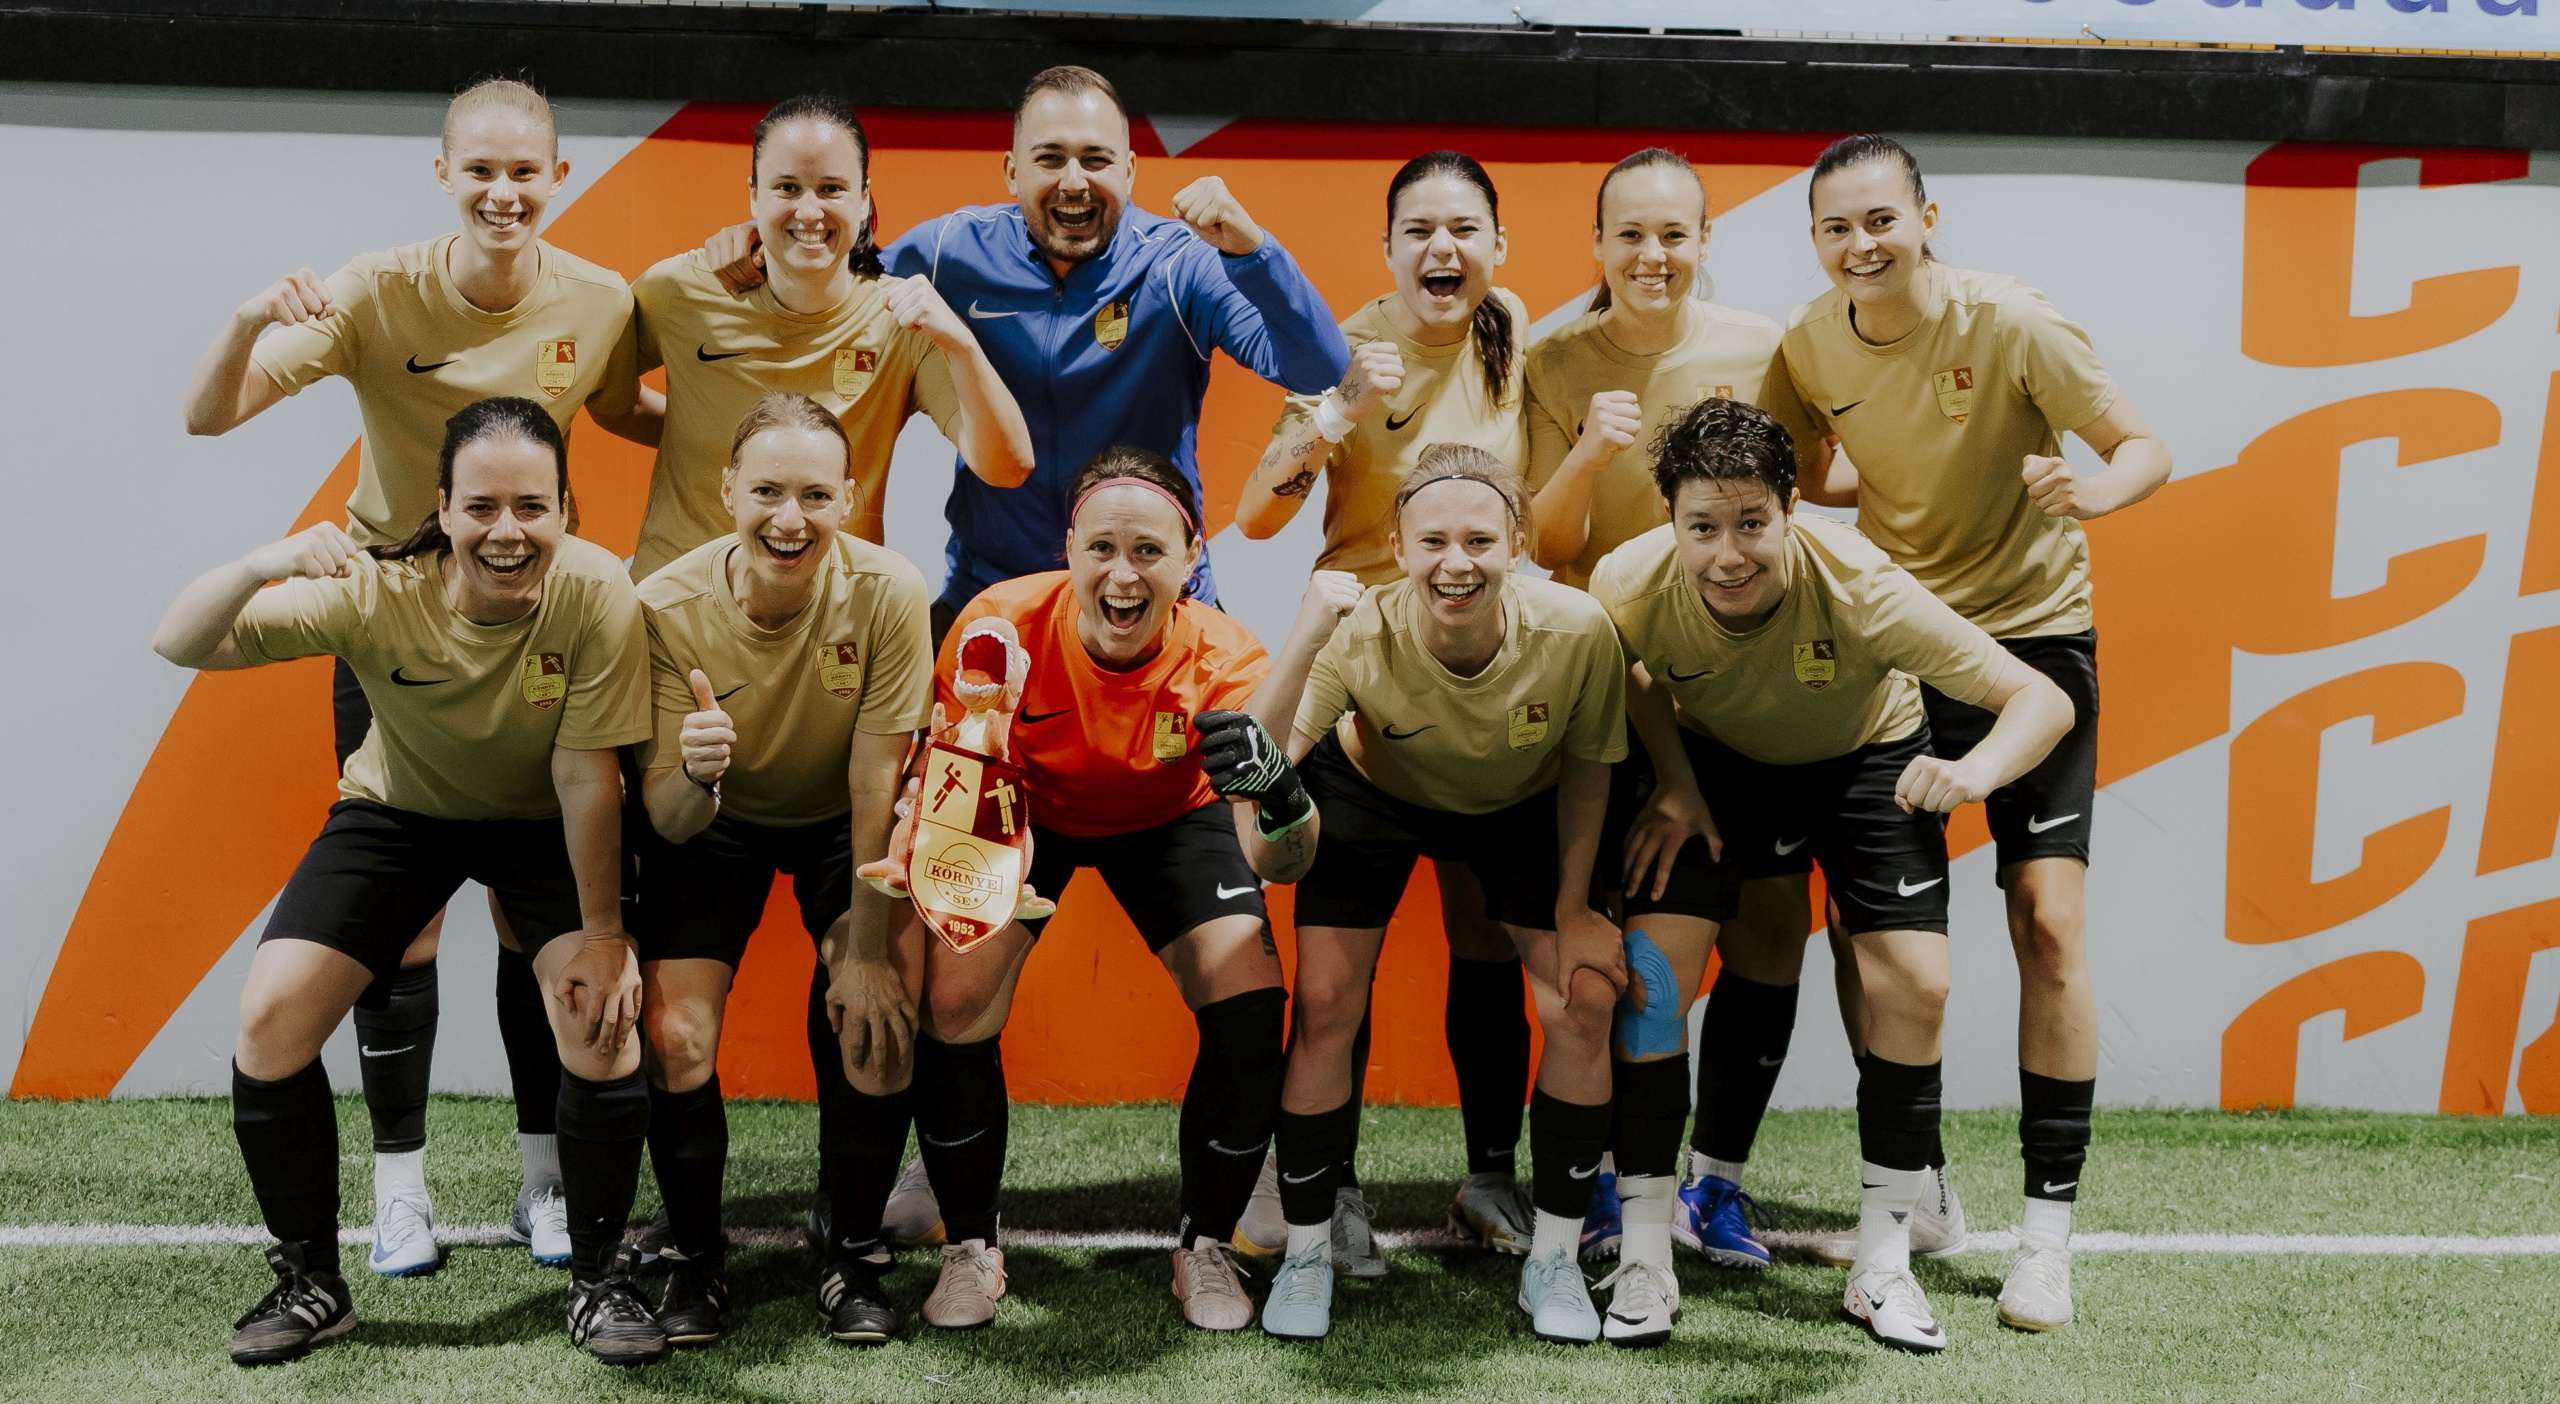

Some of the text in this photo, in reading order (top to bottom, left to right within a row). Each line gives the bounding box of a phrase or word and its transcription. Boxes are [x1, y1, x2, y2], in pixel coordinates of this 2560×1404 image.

[931, 865, 997, 890] KÖRNYE
[952, 894, 971, 906] SE
[948, 920, 975, 936] 1952
